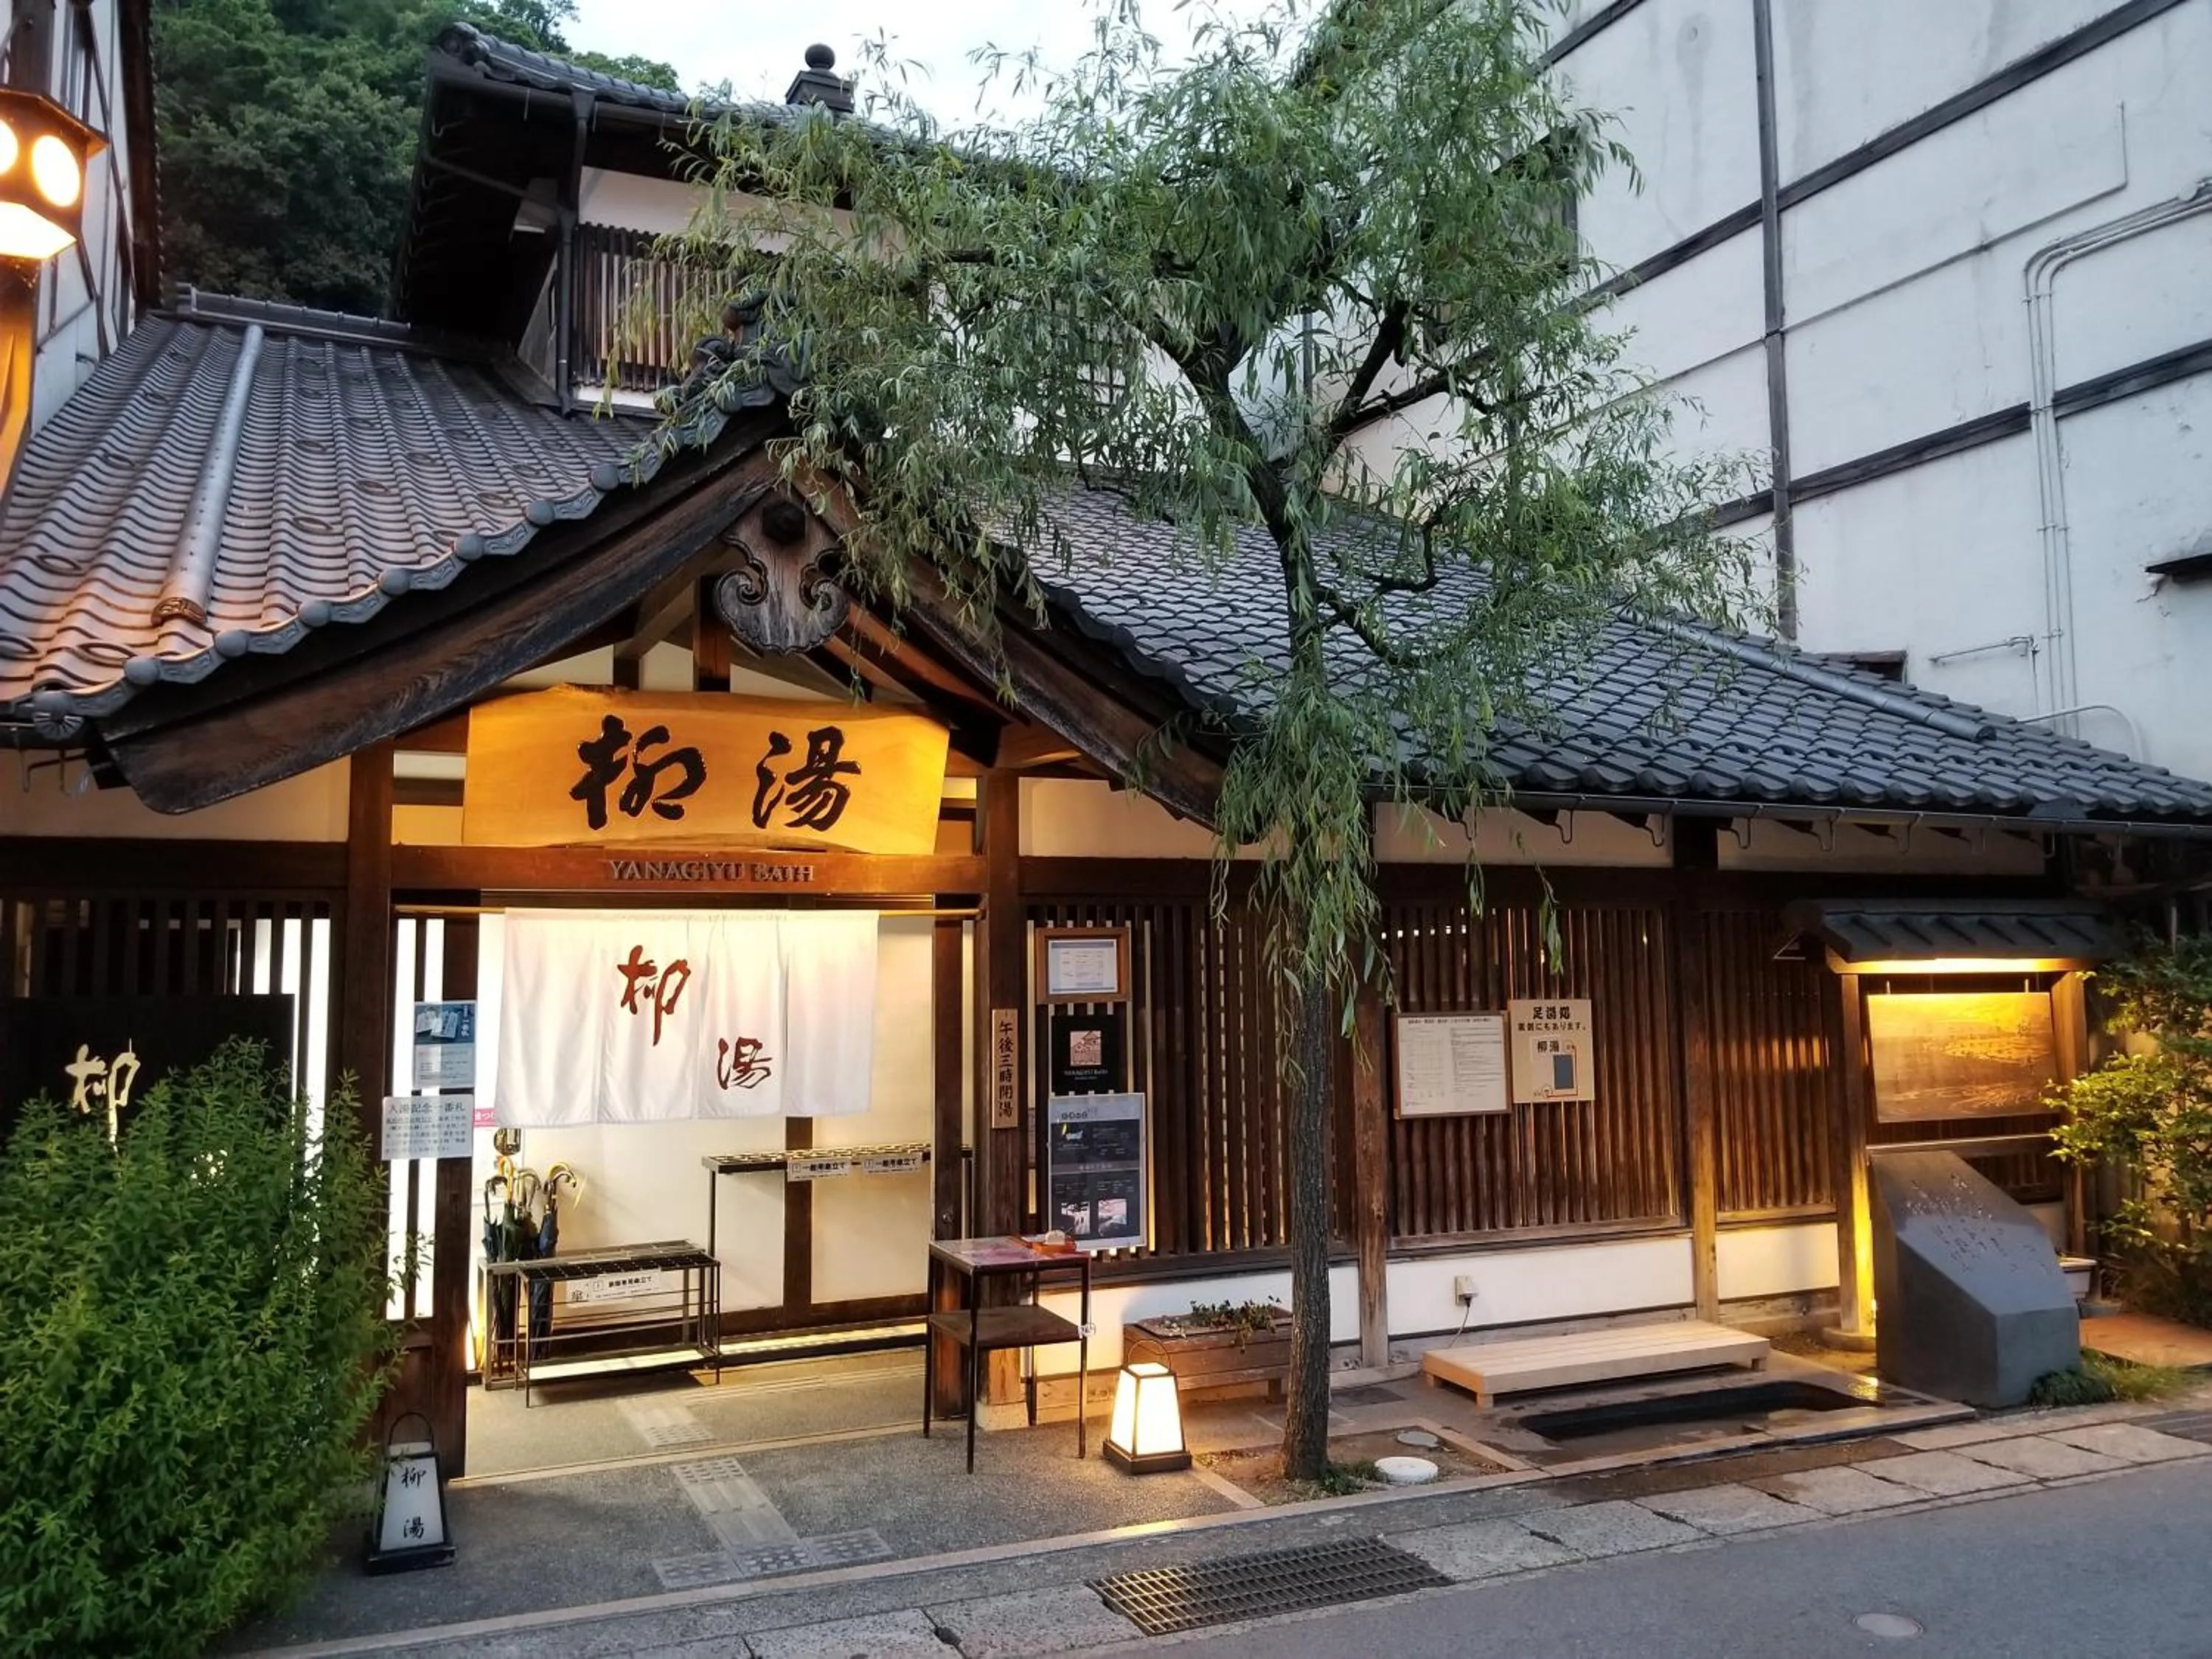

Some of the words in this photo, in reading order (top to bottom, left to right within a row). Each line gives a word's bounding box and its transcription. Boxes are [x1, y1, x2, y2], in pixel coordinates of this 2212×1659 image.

[569, 714, 861, 831] 柳湯
[610, 859, 745, 880] YANAGIYU
[754, 862, 815, 882] BATH
[617, 945, 772, 1090] 柳湯
[400, 1467, 427, 1540] 柳湯
